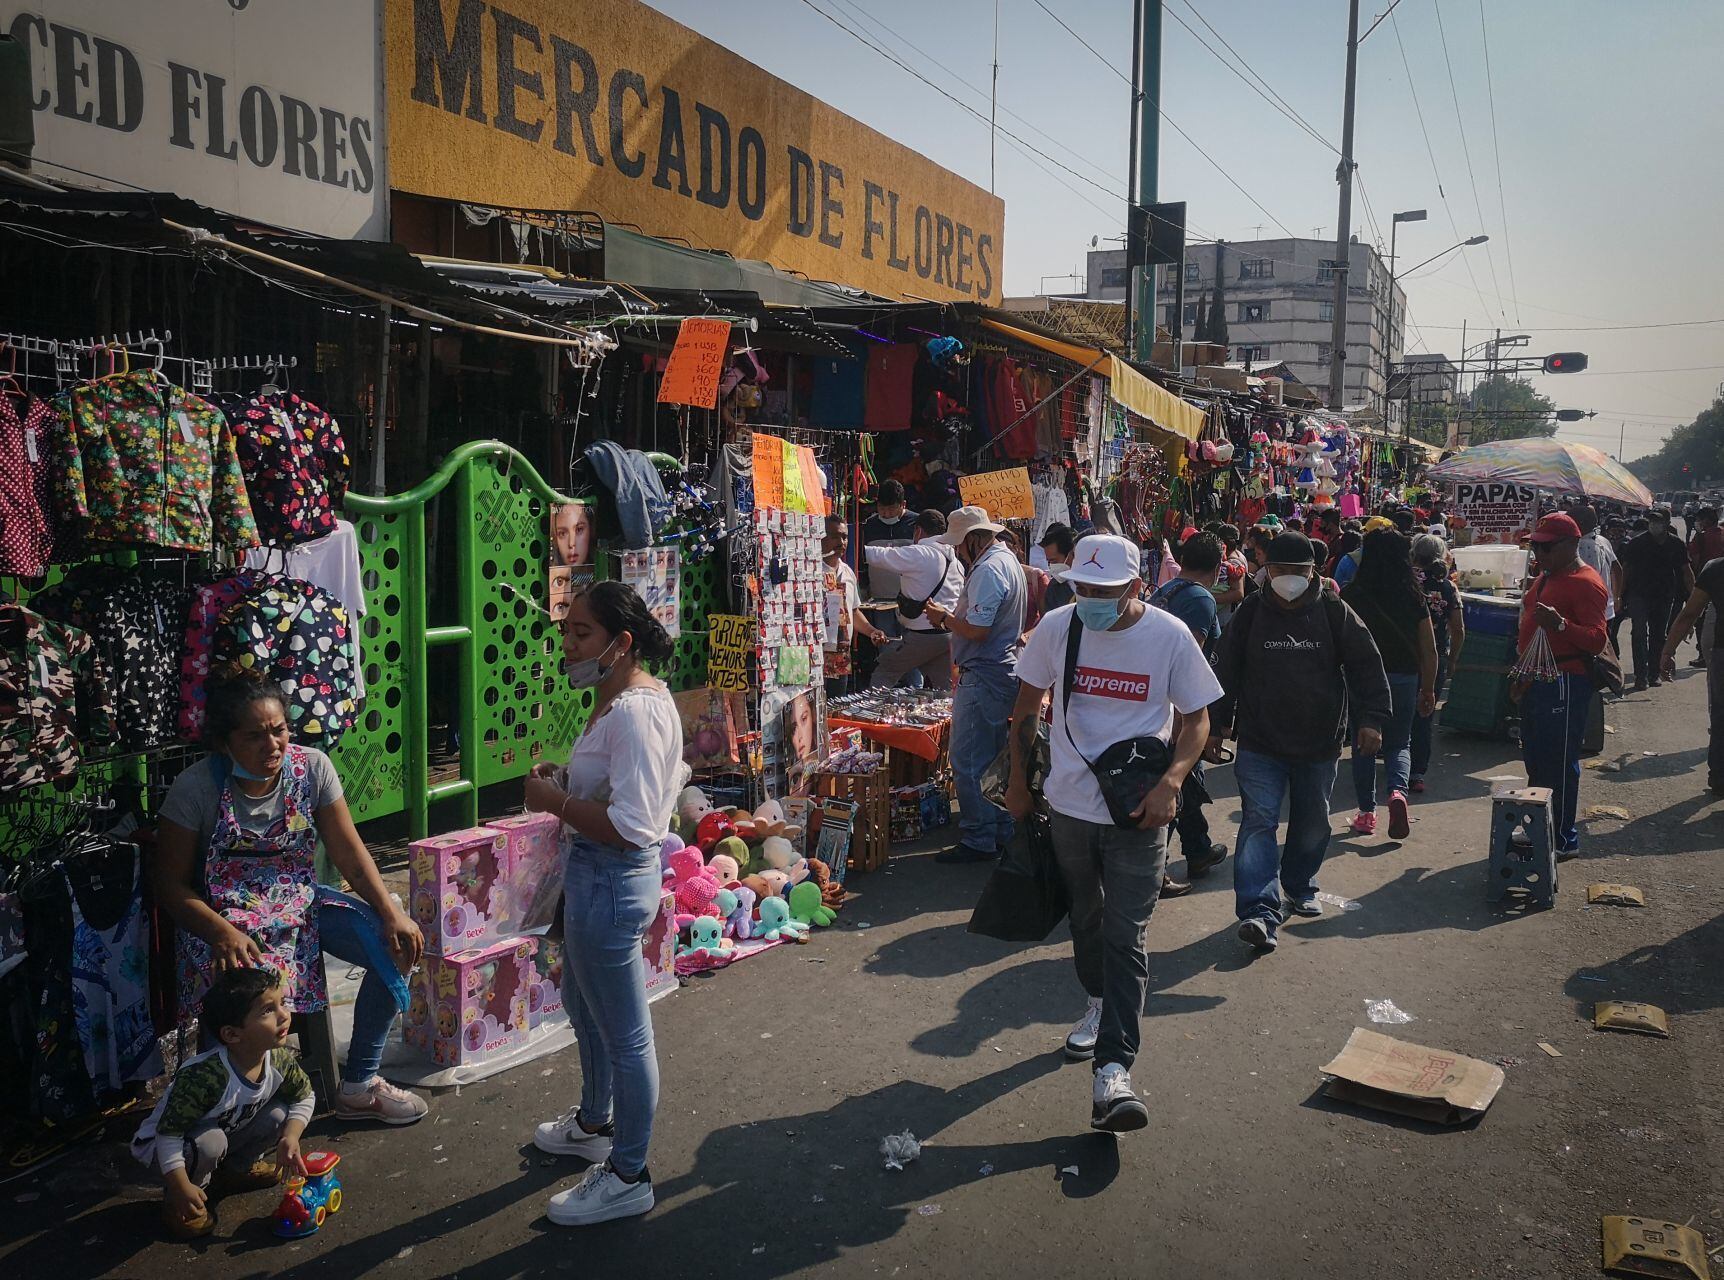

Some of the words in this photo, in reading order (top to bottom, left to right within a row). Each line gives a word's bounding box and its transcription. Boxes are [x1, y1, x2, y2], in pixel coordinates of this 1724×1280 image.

[168, 61, 373, 193] FLORES
[410, 0, 767, 221] MERCADO
[787, 144, 845, 249] DE
[861, 179, 993, 299] FLORES
[700, 342, 718, 351] USB
[702, 352, 720, 363] $50
[696, 364, 716, 374] $60
[1458, 484, 1534, 503] PAPAS
